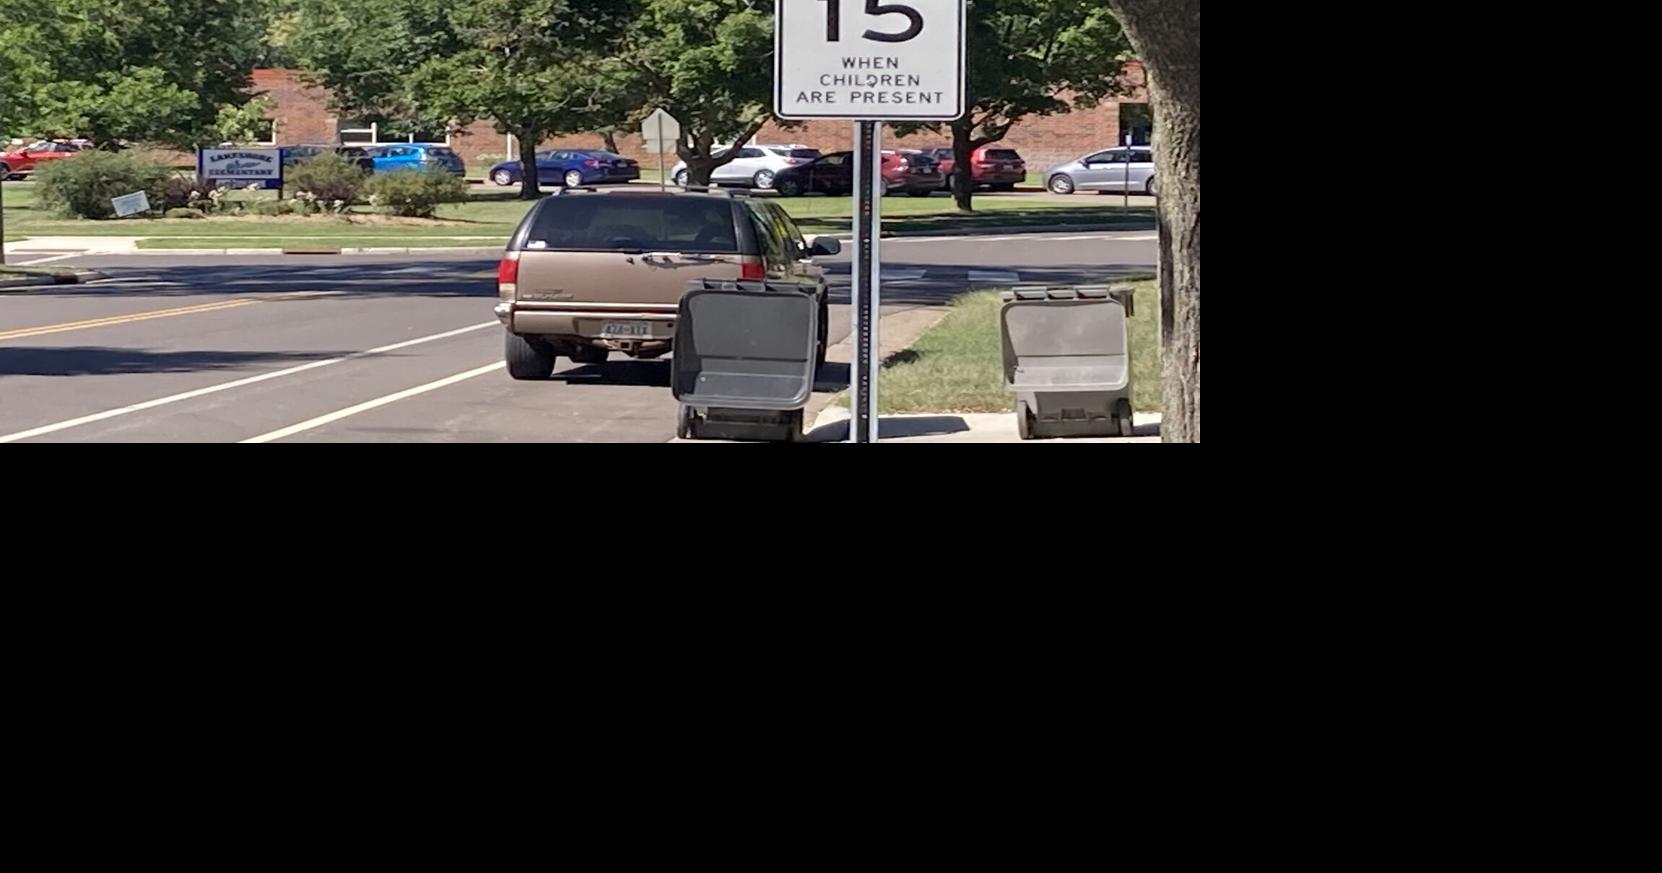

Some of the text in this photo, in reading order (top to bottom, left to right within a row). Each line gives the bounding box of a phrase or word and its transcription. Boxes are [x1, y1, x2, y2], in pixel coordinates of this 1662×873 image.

[817, 0, 924, 43] 15
[842, 56, 899, 69] WHEN
[819, 74, 920, 88] CHILDREN
[796, 91, 944, 104] ARE PRESENT
